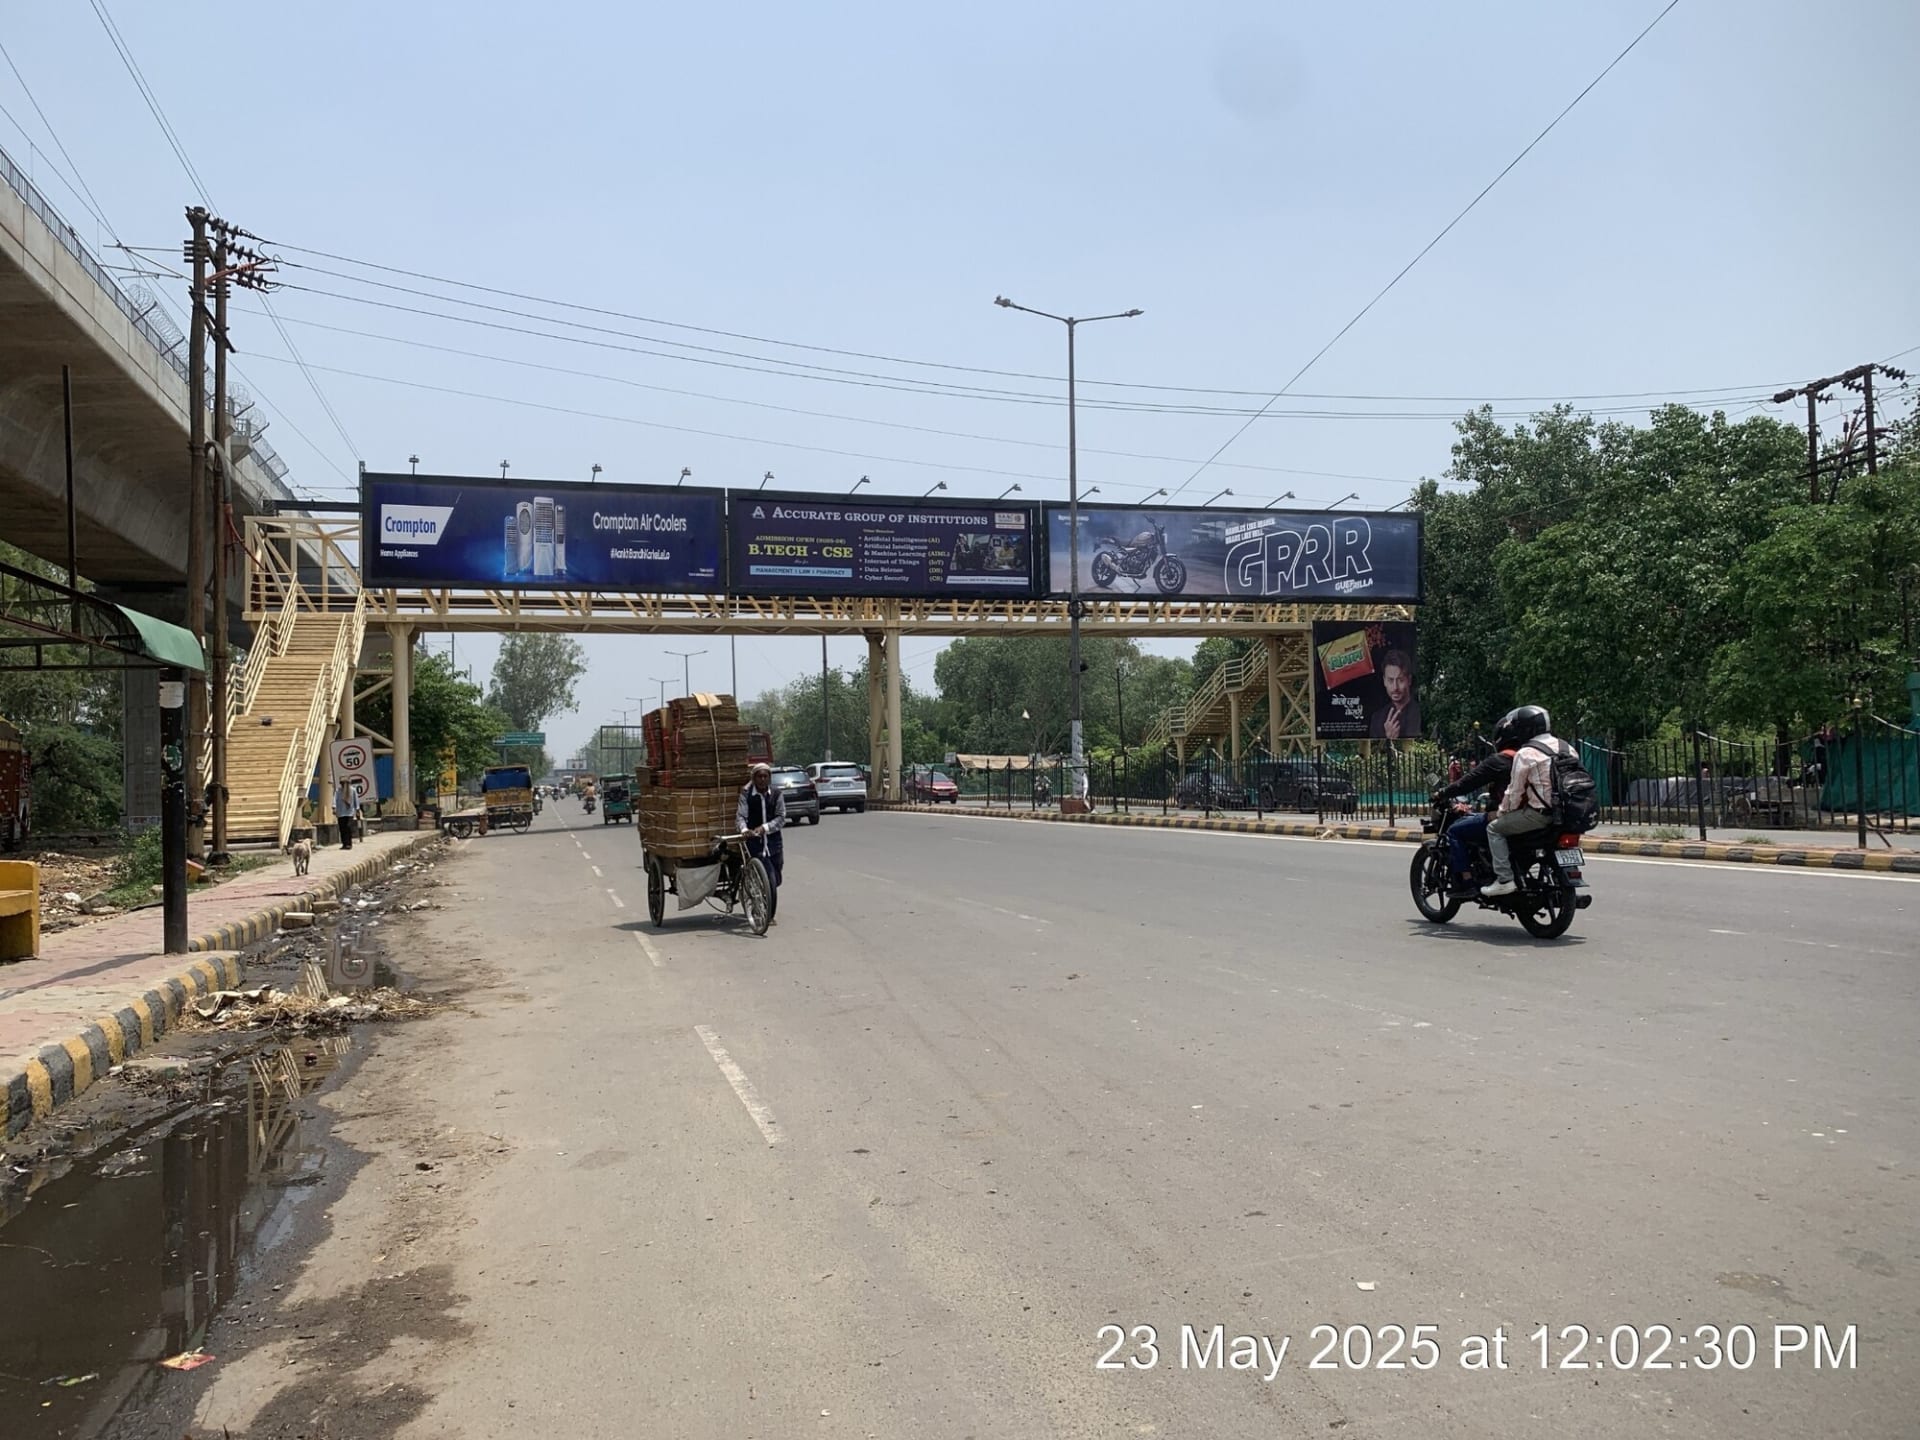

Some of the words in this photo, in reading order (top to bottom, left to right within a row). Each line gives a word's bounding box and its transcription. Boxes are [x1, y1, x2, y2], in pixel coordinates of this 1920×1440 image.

[593, 512, 639, 534] Crompton
[640, 514, 652, 532] Air
[653, 514, 688, 532] Coolers
[772, 506, 841, 520] ACCURATE
[844, 512, 886, 522] GROUP
[888, 514, 904, 522] OF
[908, 514, 988, 525] INSTITUTIONS
[385, 516, 437, 538] Crompton
[748, 544, 808, 556] B.TECH
[822, 546, 854, 558] CSE
[1334, 578, 1374, 590] GUERRILLA
[346, 757, 360, 766] 50
